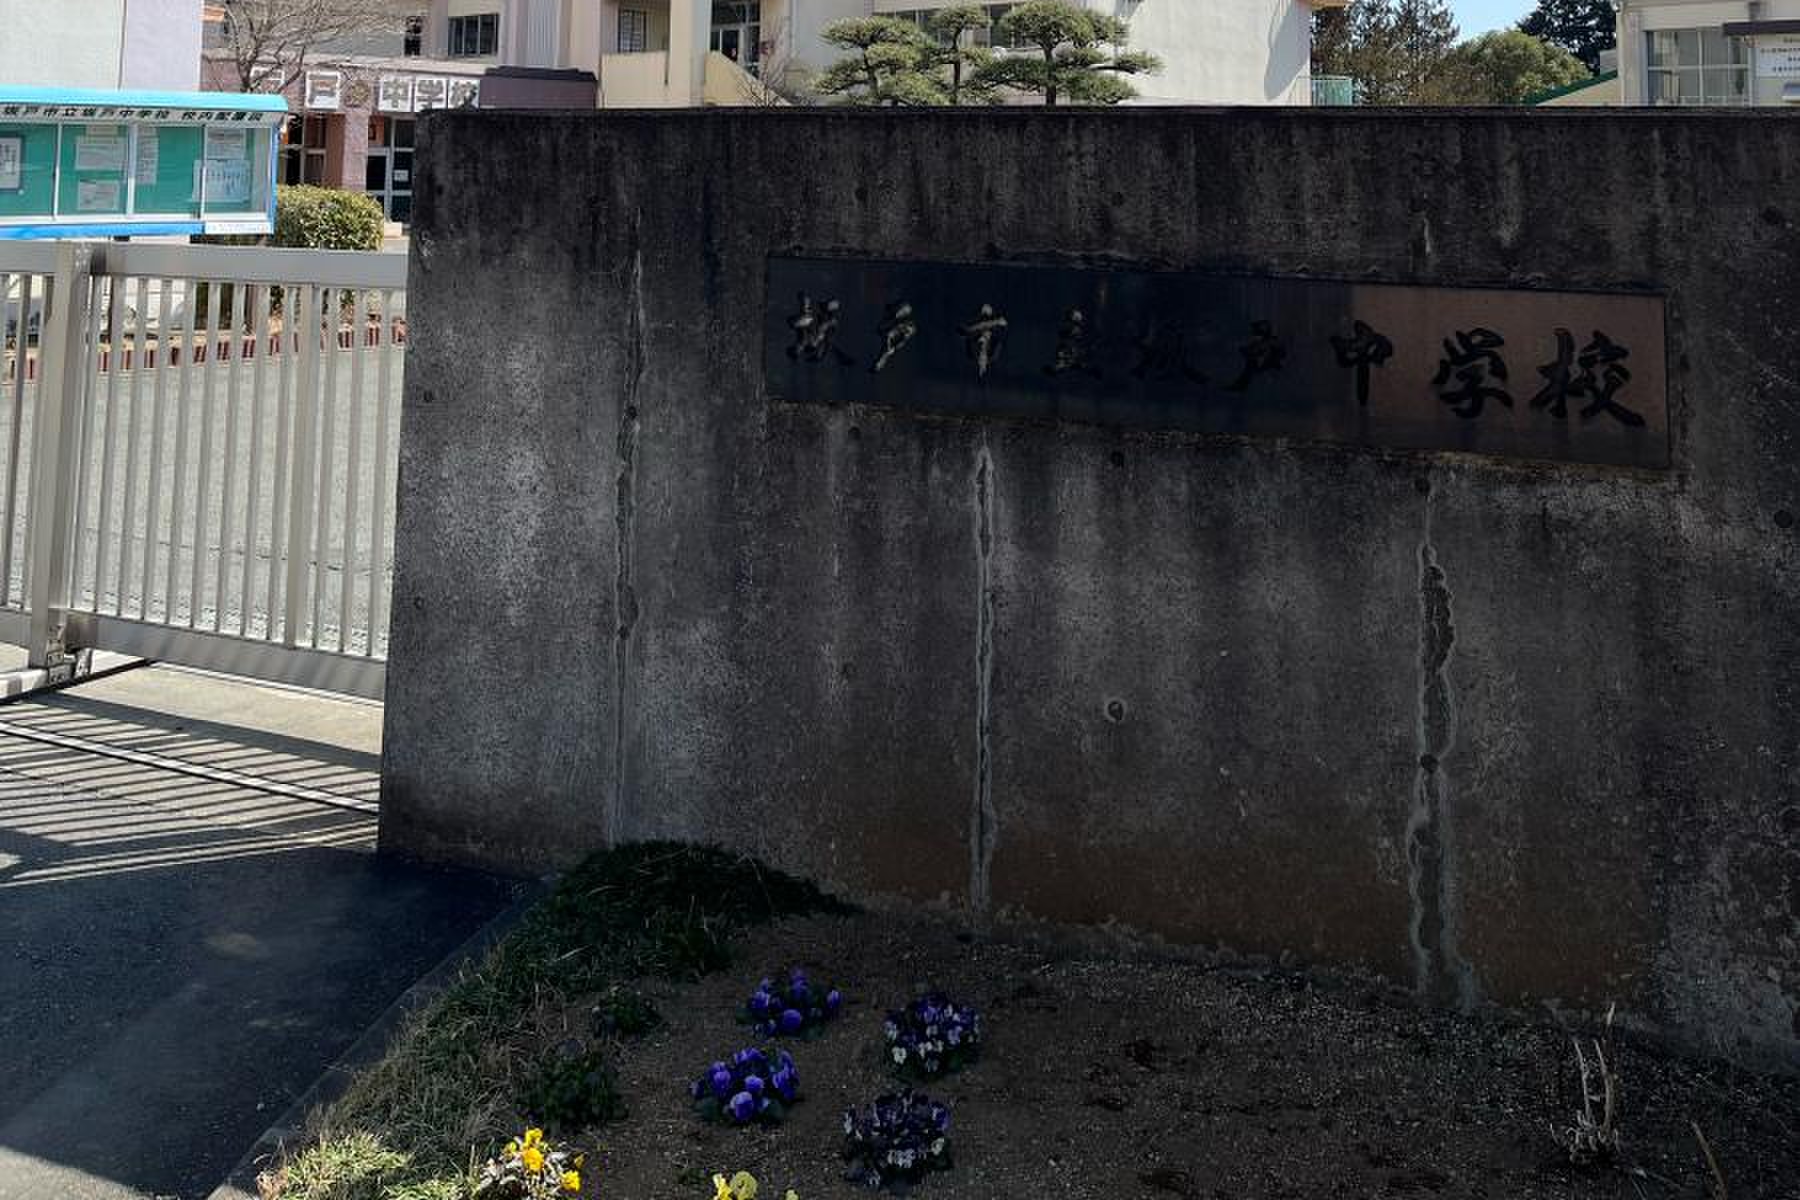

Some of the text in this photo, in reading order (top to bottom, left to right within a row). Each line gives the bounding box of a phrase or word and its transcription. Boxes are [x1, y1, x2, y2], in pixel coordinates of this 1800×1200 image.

[786, 289, 1645, 428] 坂戸市立坂戸中学校
